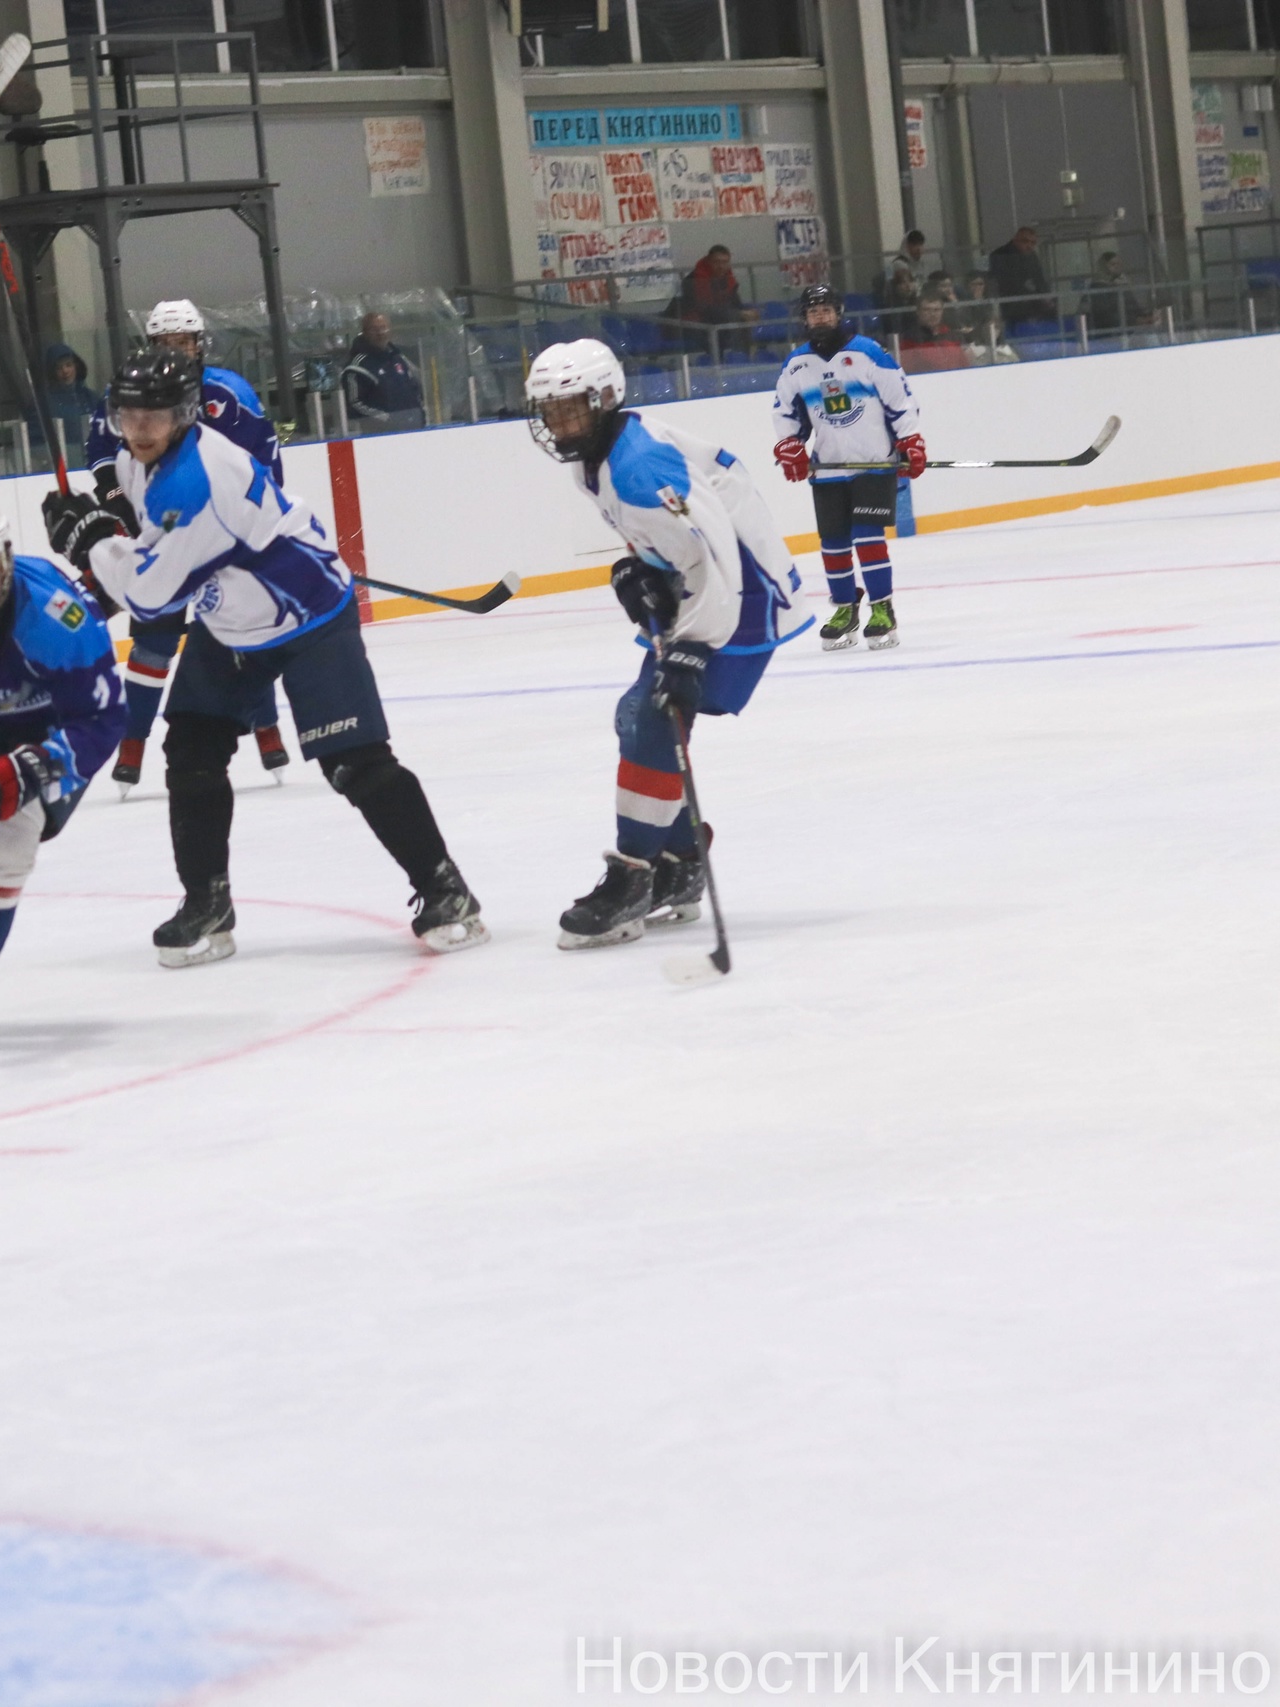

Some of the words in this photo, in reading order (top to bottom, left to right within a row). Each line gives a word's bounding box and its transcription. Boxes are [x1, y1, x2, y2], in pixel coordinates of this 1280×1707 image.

[533, 116, 601, 143] ПЕРЕД
[606, 112, 722, 138] КНЯГИНИНО
[852, 506, 892, 516] BAUER
